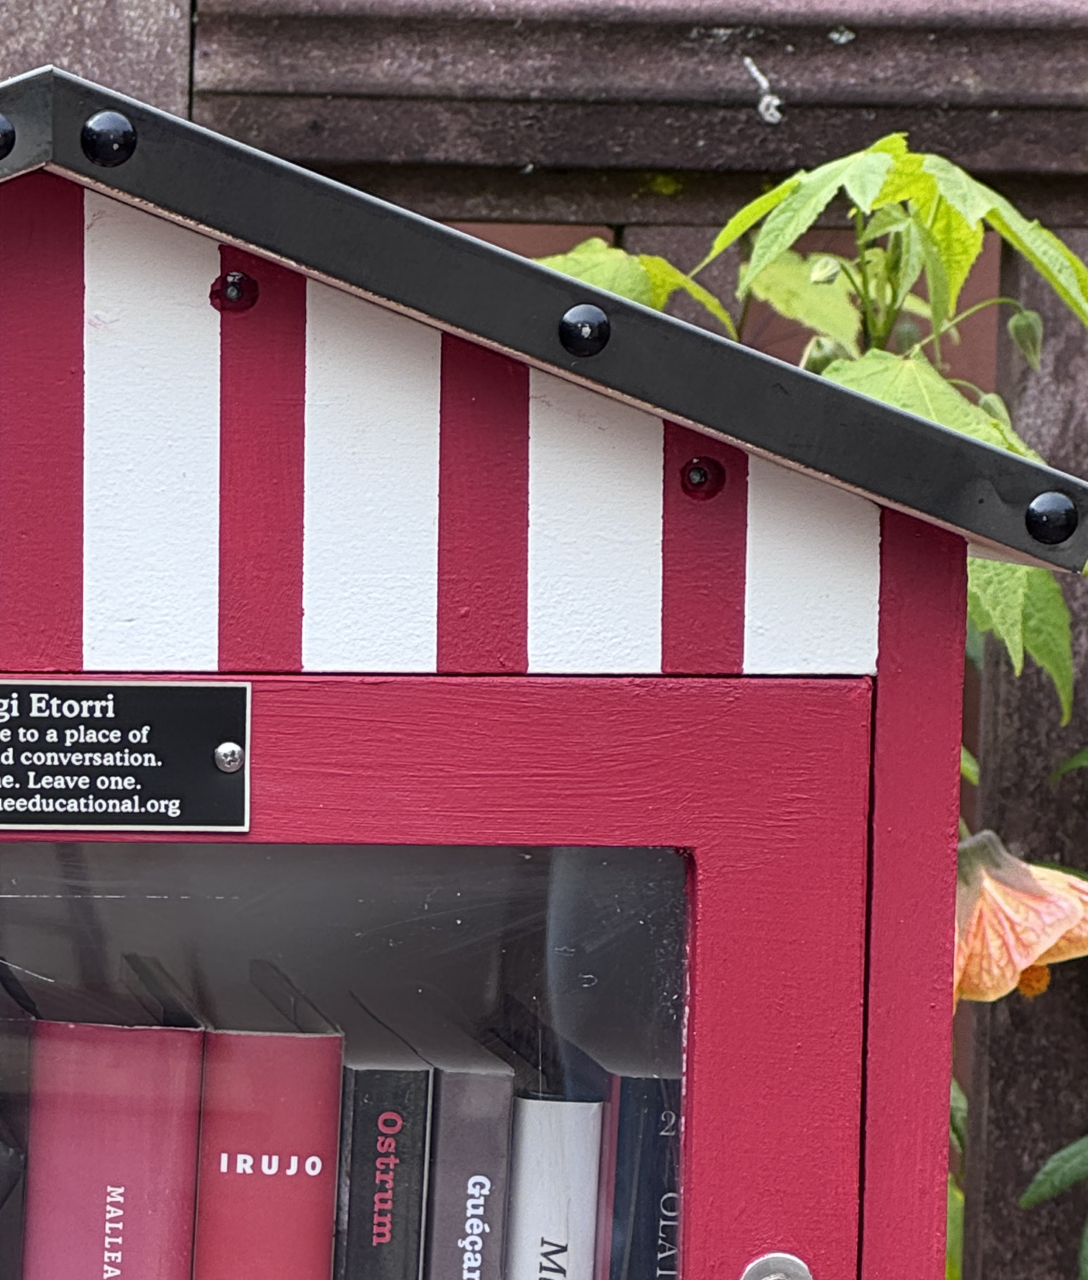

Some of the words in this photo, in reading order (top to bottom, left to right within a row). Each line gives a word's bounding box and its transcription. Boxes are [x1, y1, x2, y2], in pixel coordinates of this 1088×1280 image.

[29, 693, 115, 718] Etorri
[18, 727, 39, 743] to
[46, 730, 58, 743] a
[65, 725, 121, 747] place
[128, 726, 151, 744] of
[20, 750, 163, 767] conversation.
[27, 773, 90, 790] Leave
[96, 776, 142, 790] one.
[659, 1110, 677, 1137] 2
[220, 1152, 323, 1176] IRUJO
[372, 1111, 403, 1245] Ostrum
